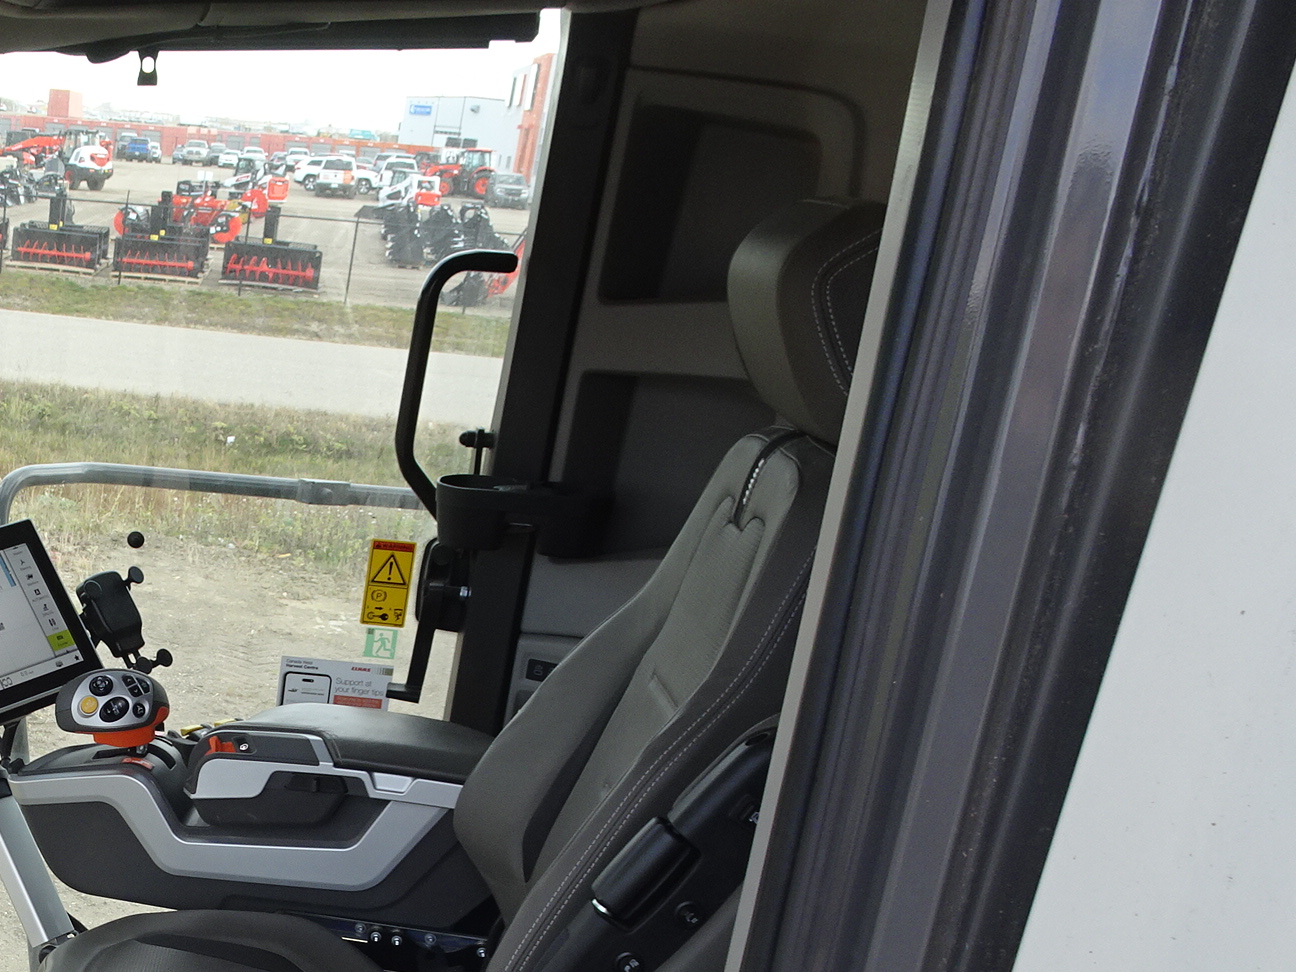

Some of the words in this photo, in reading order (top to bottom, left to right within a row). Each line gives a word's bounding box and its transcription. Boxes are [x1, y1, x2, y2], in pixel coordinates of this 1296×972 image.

[335, 677, 364, 687] Support
[334, 686, 350, 694] your
[351, 686, 371, 696] finger
[372, 688, 384, 697] tips
